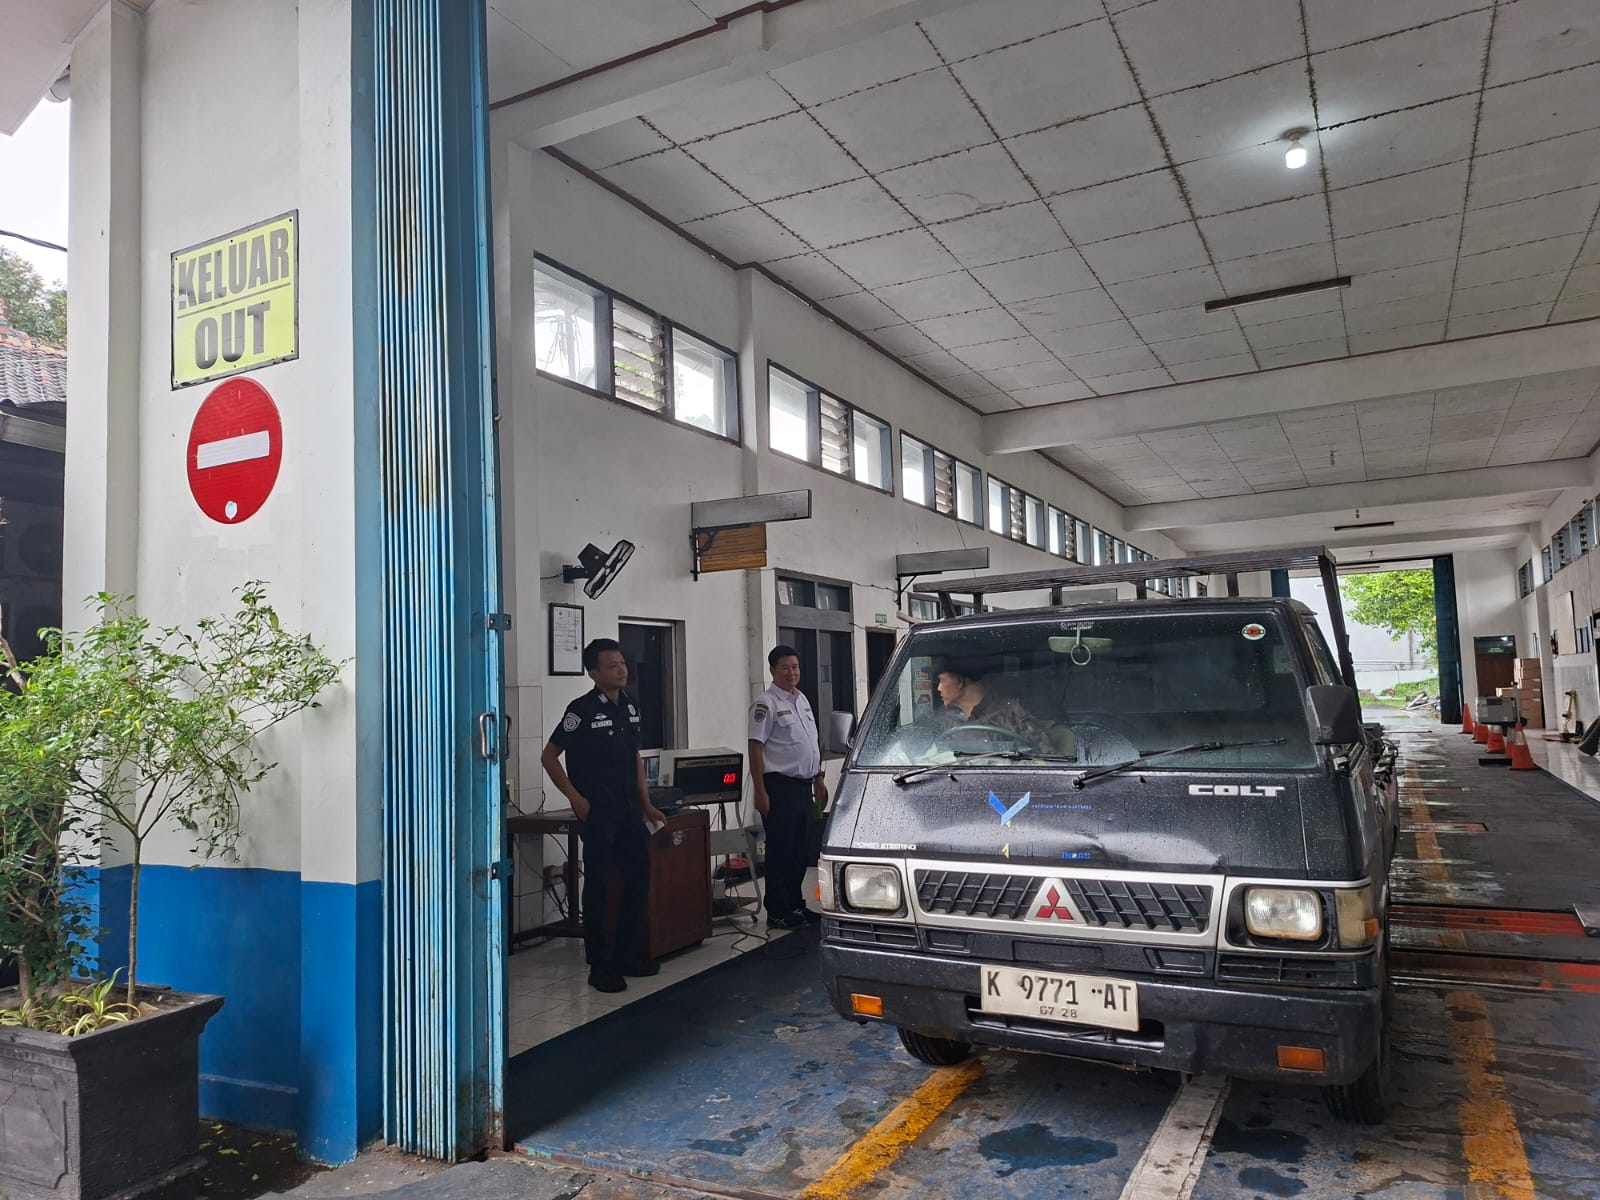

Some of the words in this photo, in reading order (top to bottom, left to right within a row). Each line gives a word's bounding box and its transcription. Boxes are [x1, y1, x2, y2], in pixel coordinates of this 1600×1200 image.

[178, 227, 290, 311] KELUAR
[194, 300, 271, 370] OUT
[1188, 784, 1285, 798] COLT
[987, 970, 1001, 998] K
[1020, 974, 1079, 1005] 9771
[1103, 983, 1132, 1012] AT
